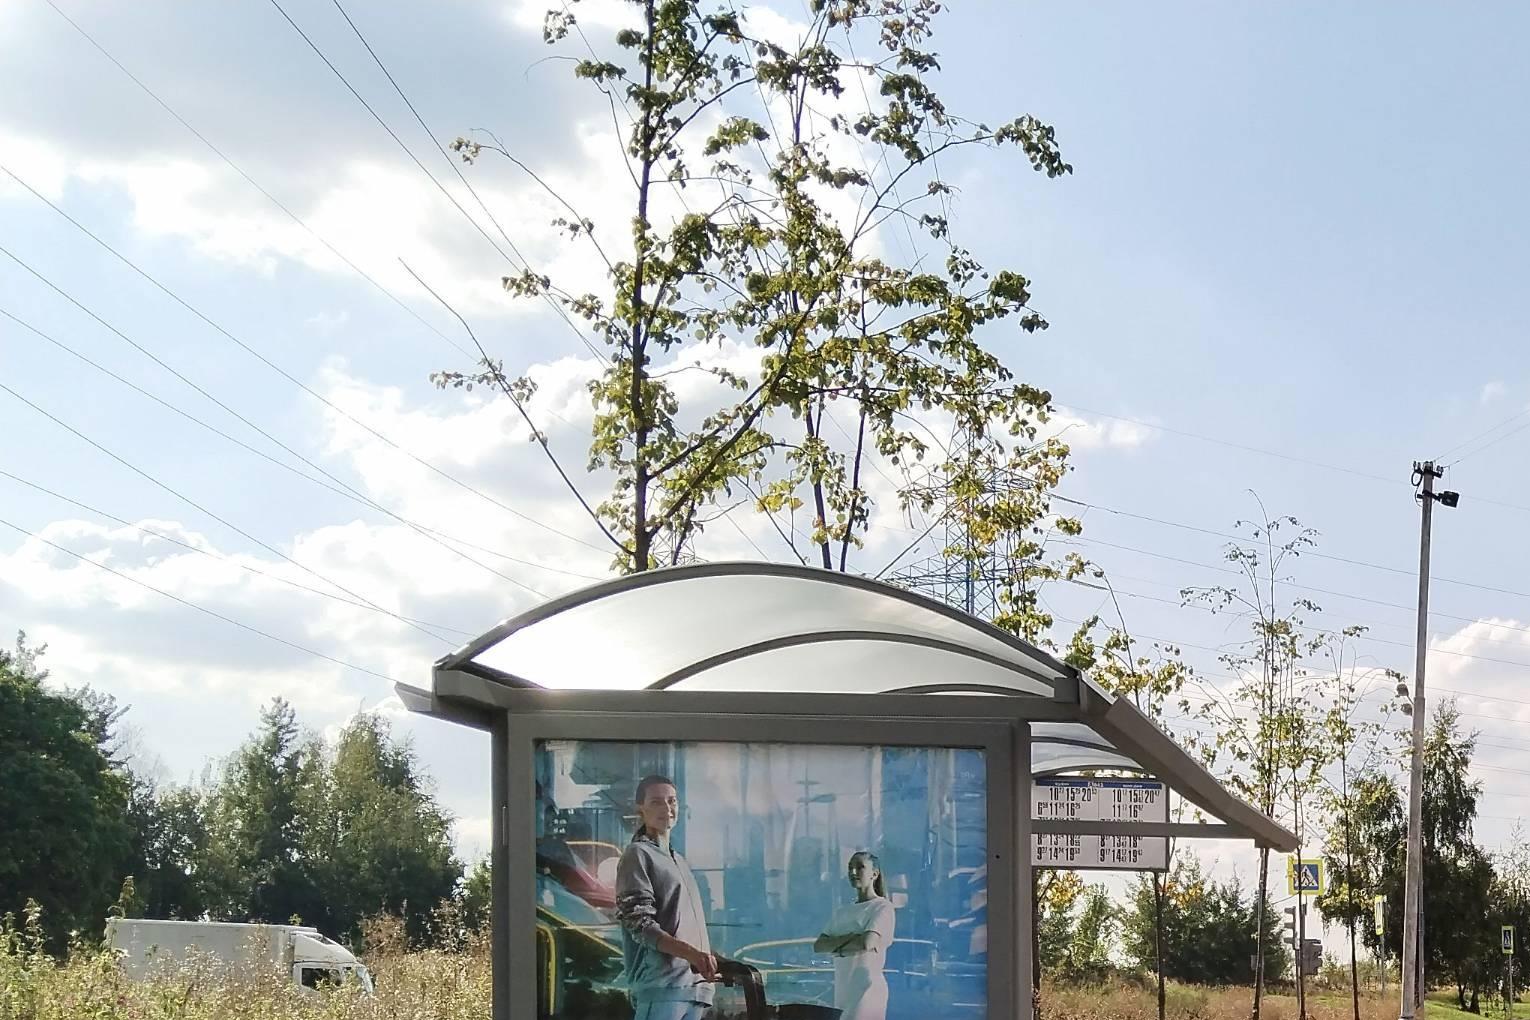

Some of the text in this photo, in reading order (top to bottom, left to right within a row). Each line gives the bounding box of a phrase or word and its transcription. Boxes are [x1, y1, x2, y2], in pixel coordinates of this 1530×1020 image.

[1050, 788, 1058, 800] 10
[1066, 788, 1075, 801] 15
[1082, 788, 1091, 802] 20
[1113, 789, 1122, 802] 10
[1129, 790, 1138, 803] 15
[1145, 790, 1154, 804] 20
[1050, 802, 1058, 816] 11
[1066, 803, 1075, 816] 16
[1113, 805, 1121, 818] 11
[1129, 805, 1138, 818] 16
[1049, 847, 1058, 860] 14
[1066, 848, 1074, 861] 19
[1112, 849, 1121, 862] 14
[1128, 850, 1137, 863] 19
